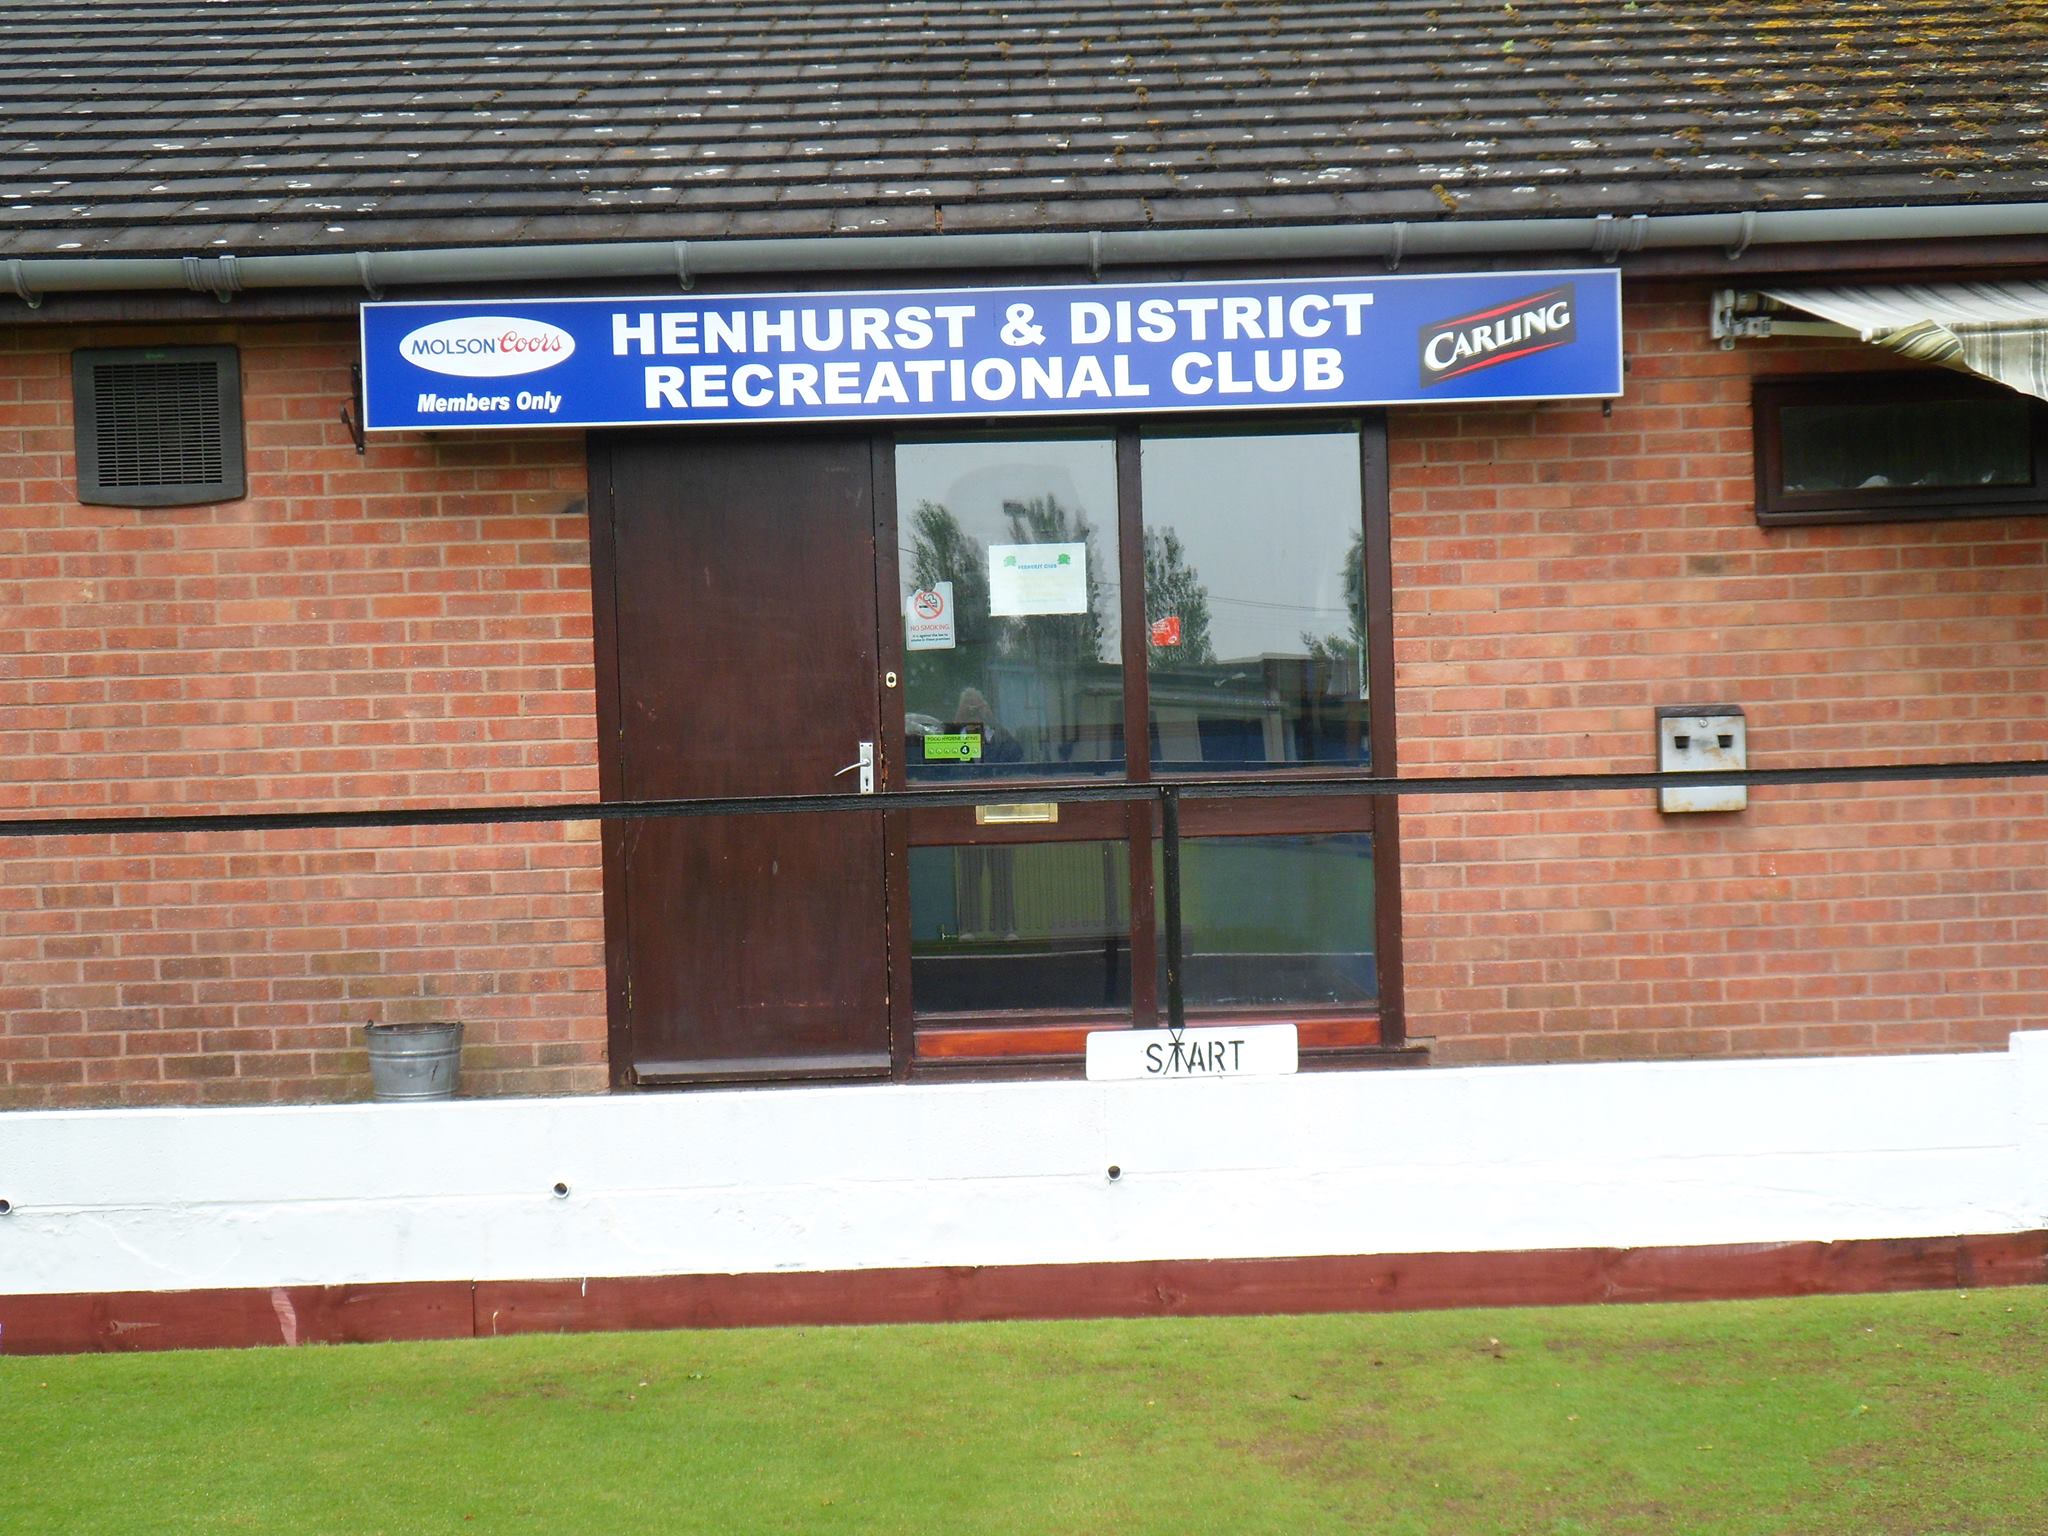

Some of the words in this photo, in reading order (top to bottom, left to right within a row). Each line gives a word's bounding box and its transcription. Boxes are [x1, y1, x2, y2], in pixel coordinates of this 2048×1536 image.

[412, 337, 496, 356] MOLSON
[498, 330, 563, 354] Coors
[612, 304, 976, 355] HENHURST
[1000, 303, 1047, 347] &
[1070, 293, 1374, 345] DISTRICT
[1424, 301, 1571, 372] CARLING
[644, 355, 1150, 409] RECREATIONAL
[1171, 347, 1345, 394] CLUB
[417, 393, 510, 413] Members
[516, 391, 562, 413] Only
[1146, 1040, 1245, 1073] START
